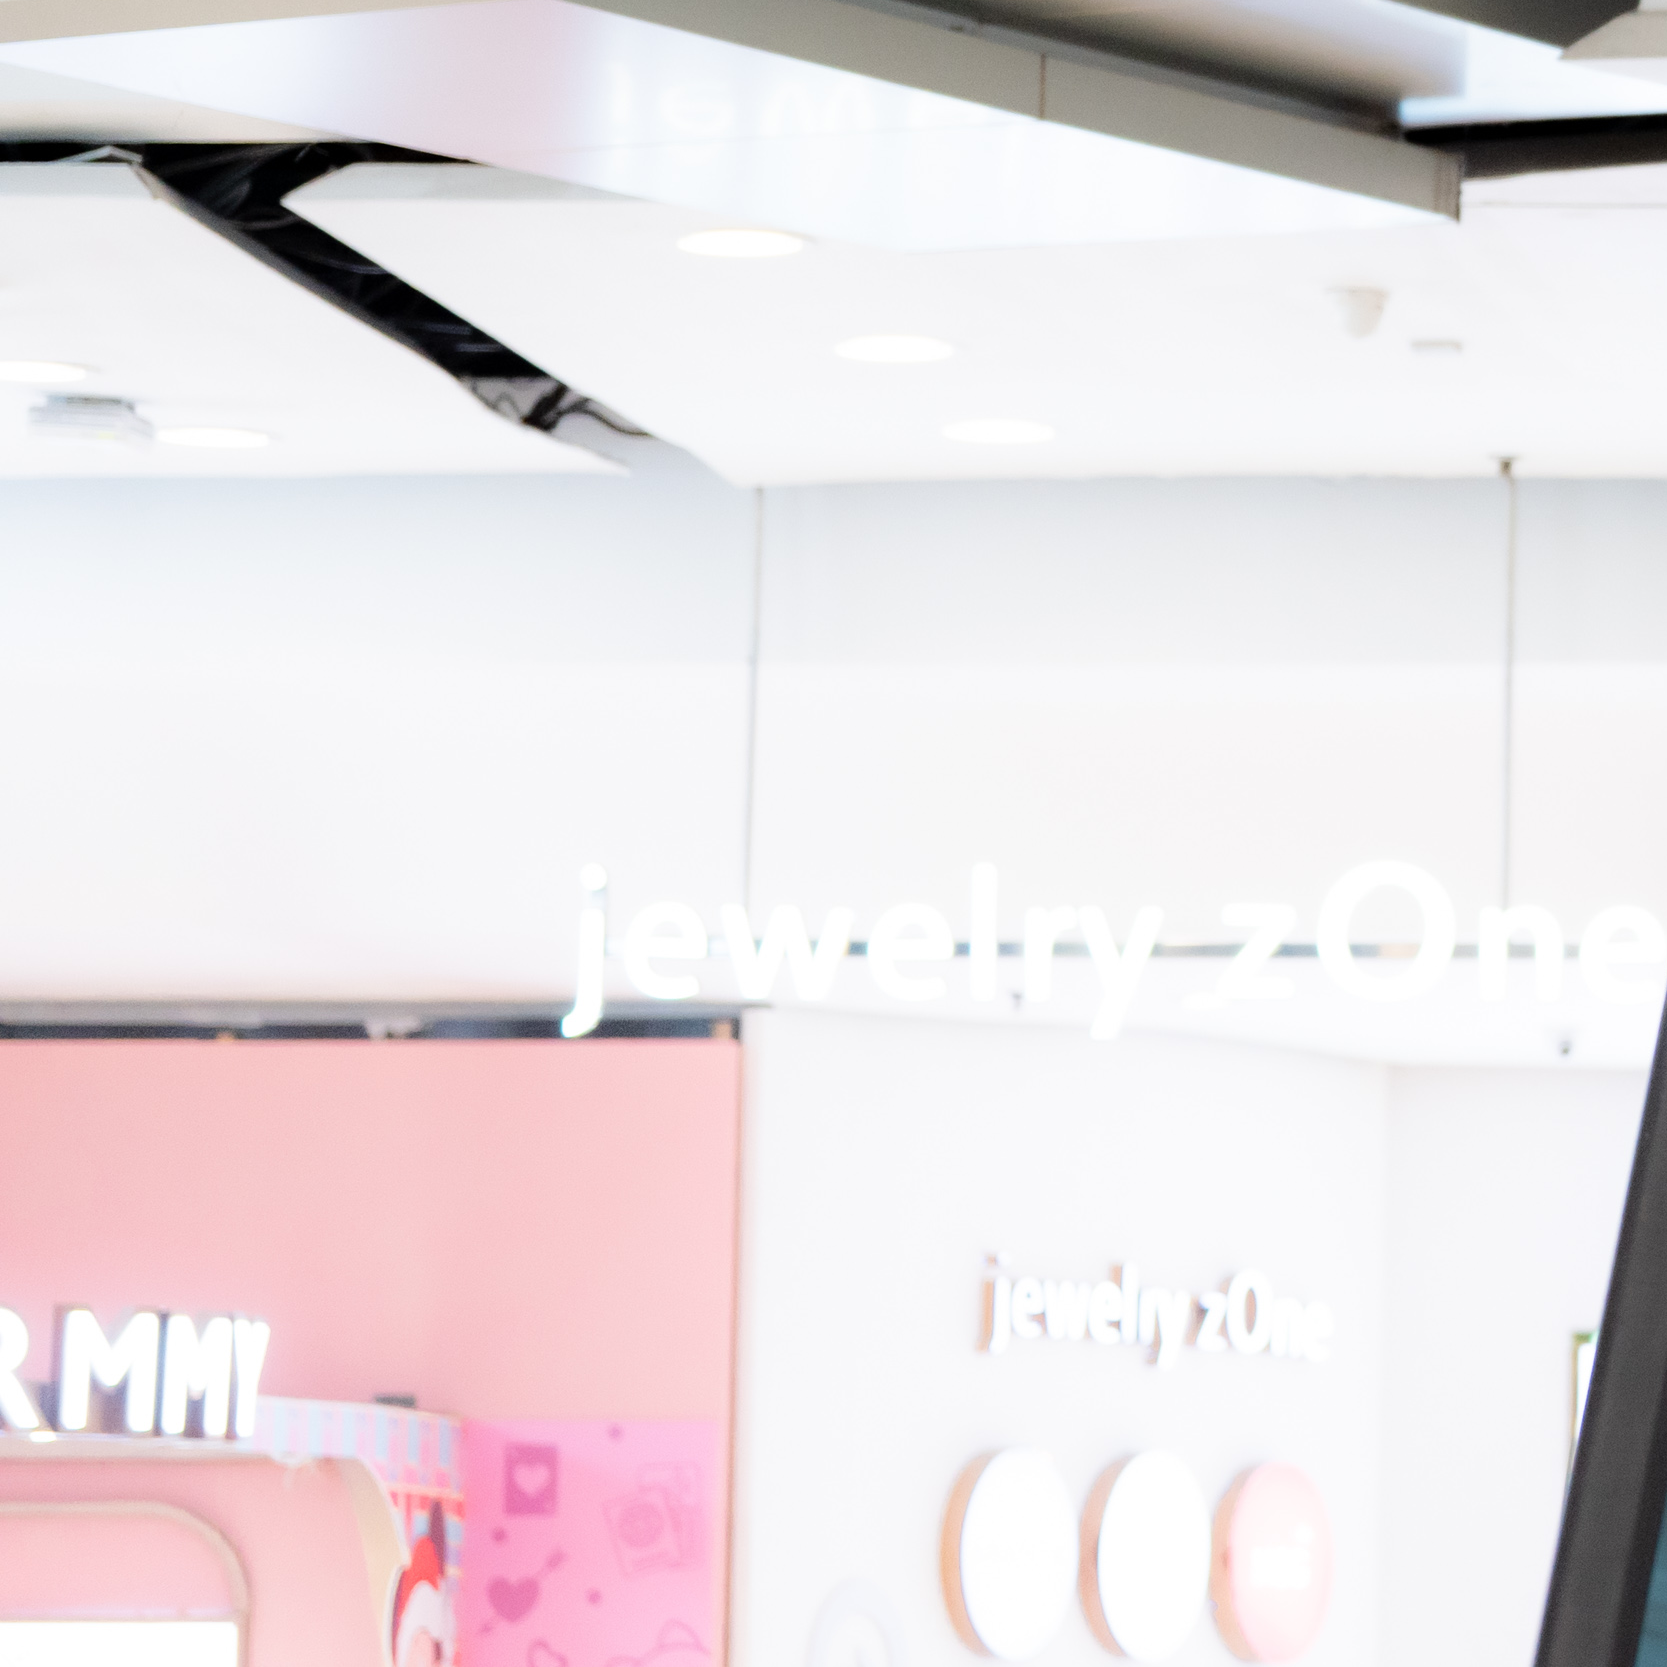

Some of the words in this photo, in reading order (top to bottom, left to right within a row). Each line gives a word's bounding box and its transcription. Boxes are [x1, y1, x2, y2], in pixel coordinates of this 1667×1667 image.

[561, 861, 1165, 1041] jewelry
[982, 1252, 1192, 1371] jewelry
[1194, 1267, 1334, 1363] zOne
